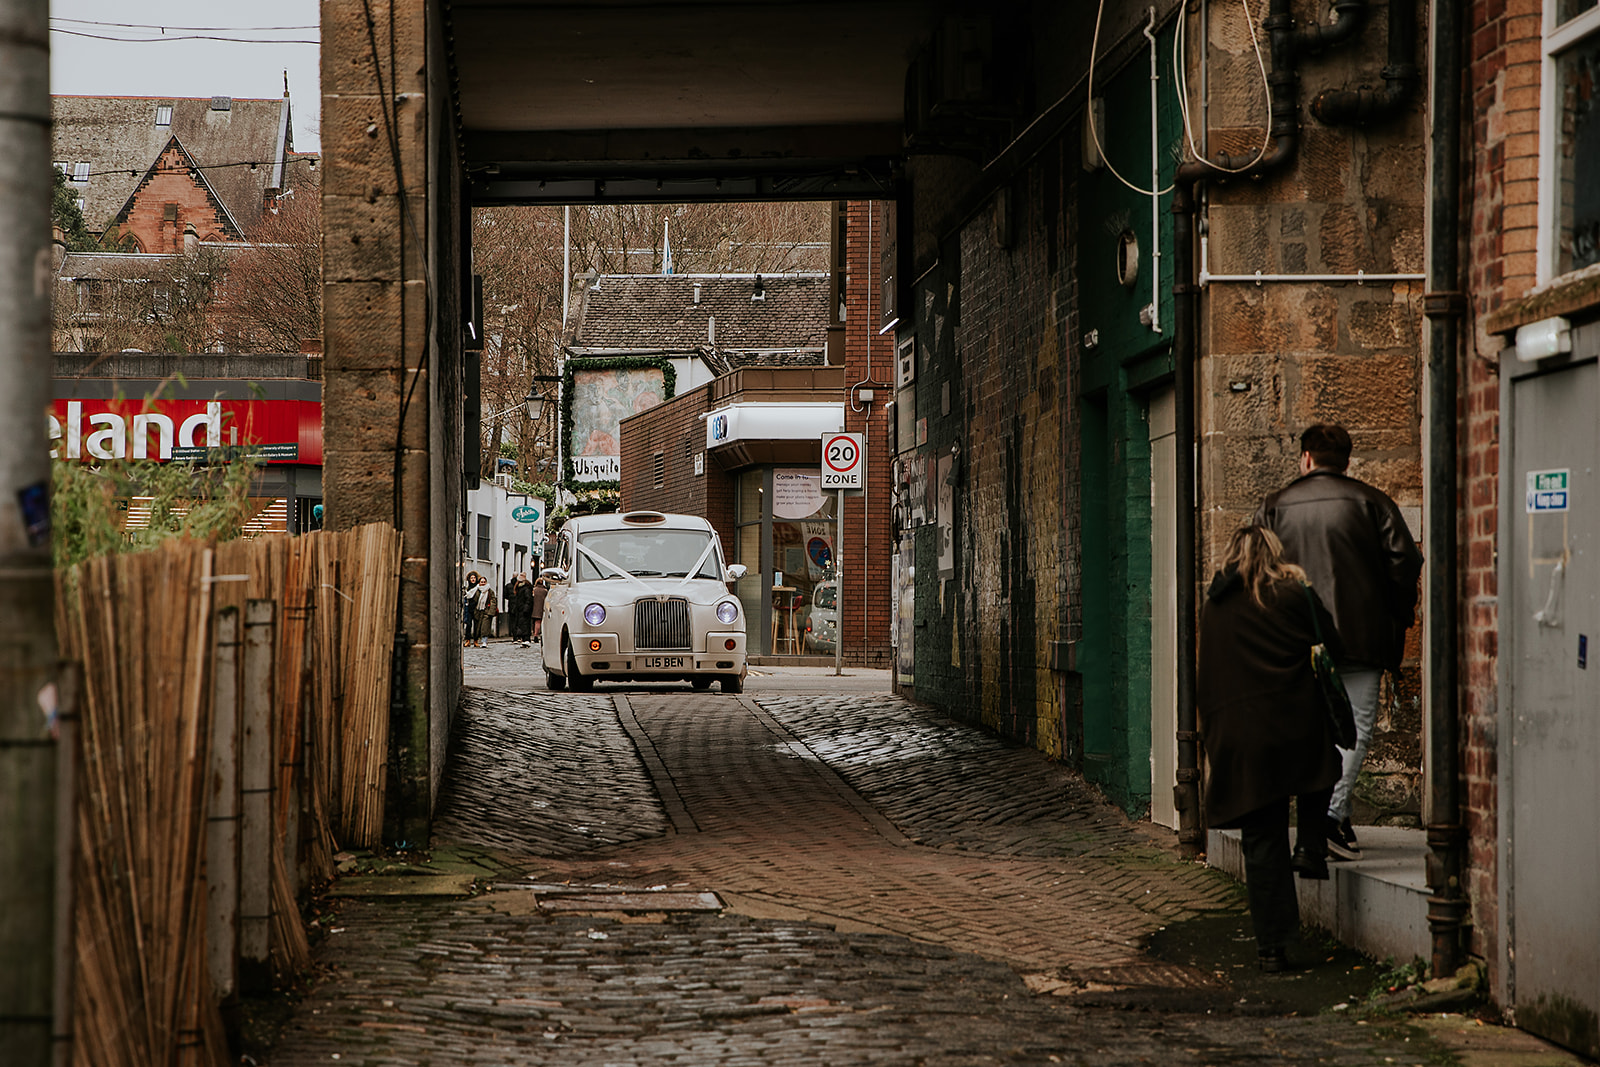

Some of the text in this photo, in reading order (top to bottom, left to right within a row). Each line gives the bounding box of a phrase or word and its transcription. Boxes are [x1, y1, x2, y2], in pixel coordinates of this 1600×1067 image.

[830, 446, 854, 461] 20
[575, 458, 619, 479] Ubiquito
[825, 475, 857, 484] ZONE
[664, 657, 684, 668] BEN
